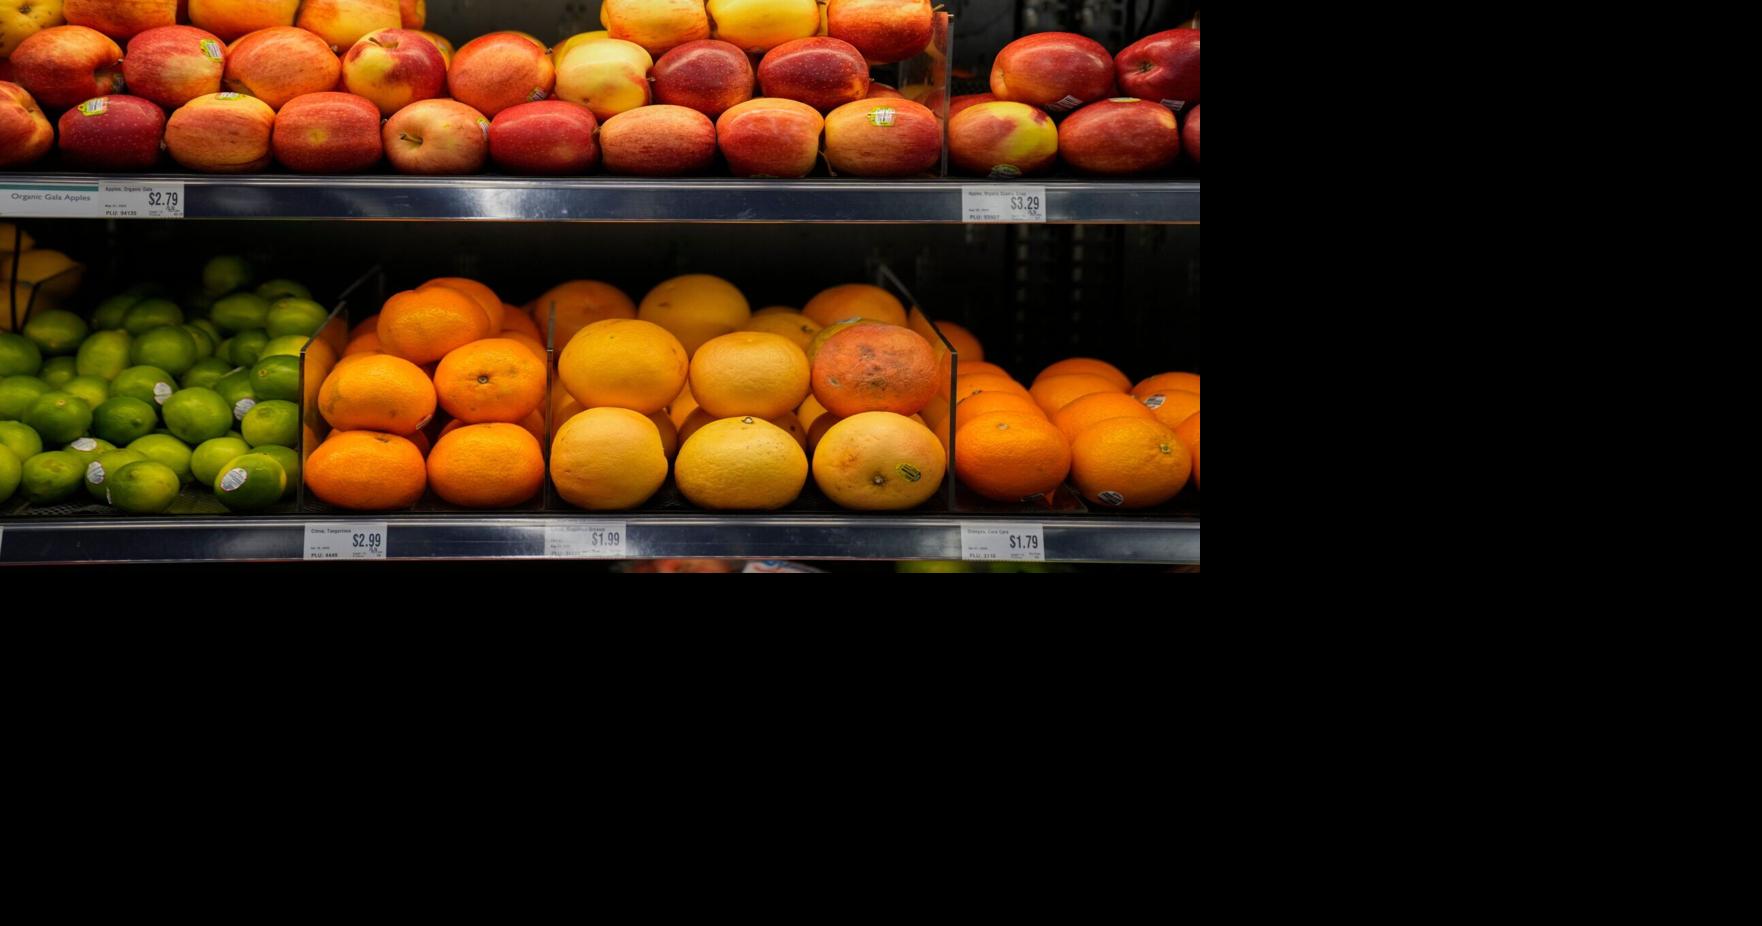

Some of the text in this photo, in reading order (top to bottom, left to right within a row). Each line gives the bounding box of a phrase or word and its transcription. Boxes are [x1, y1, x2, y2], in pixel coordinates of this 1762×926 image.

[11, 192, 91, 203] Organic Gala Apples
[148, 191, 178, 206] $2.79
[1010, 196, 1040, 210] $3.29
[352, 533, 381, 547] $2.99
[591, 531, 620, 546] $1.99
[1009, 534, 1038, 549] $1.79
